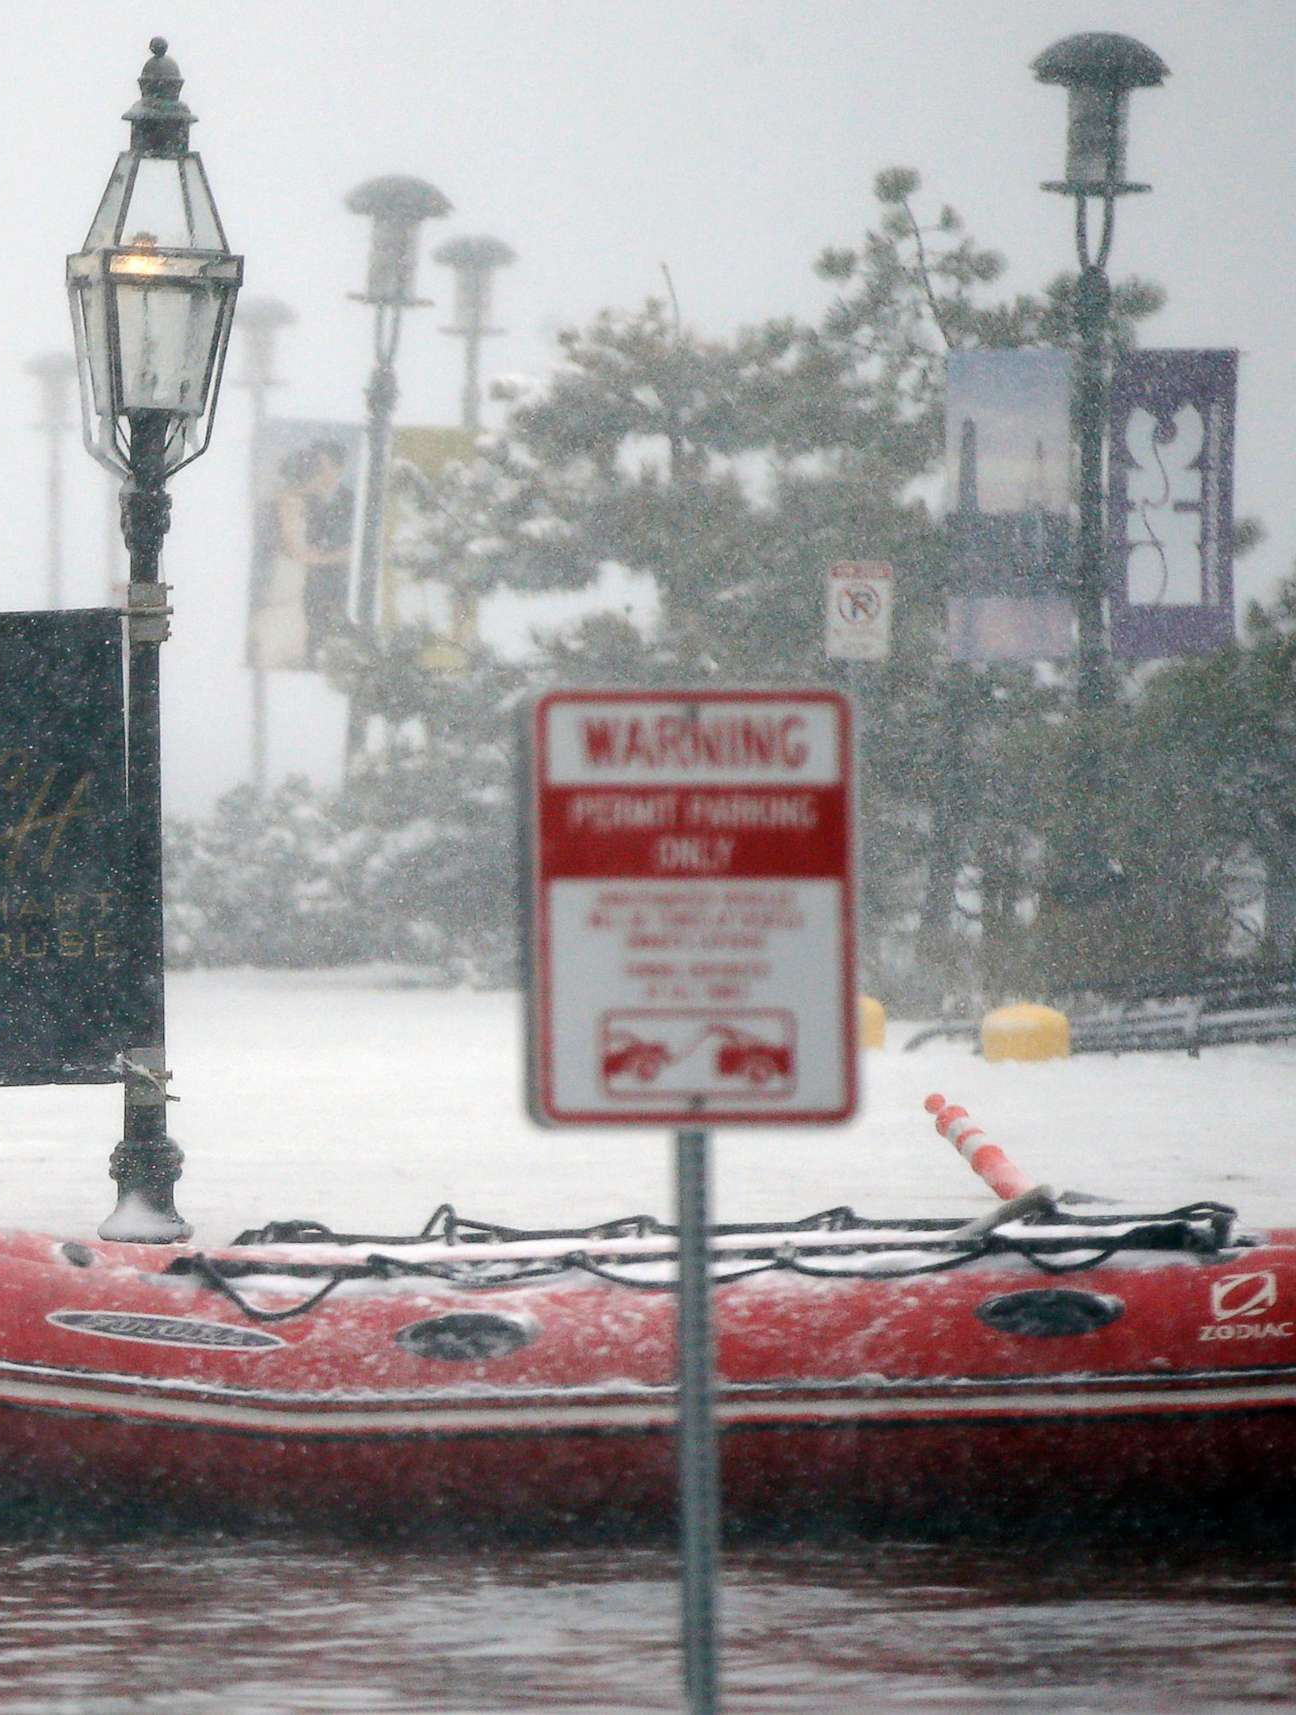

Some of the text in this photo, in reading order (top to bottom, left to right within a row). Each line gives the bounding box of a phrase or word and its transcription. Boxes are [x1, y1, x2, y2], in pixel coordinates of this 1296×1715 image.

[581, 715, 810, 770] WARNING
[690, 796, 819, 829] PARKING
[656, 836, 736, 869] ONLY
[1198, 1321, 1295, 1342] ZODIAC
